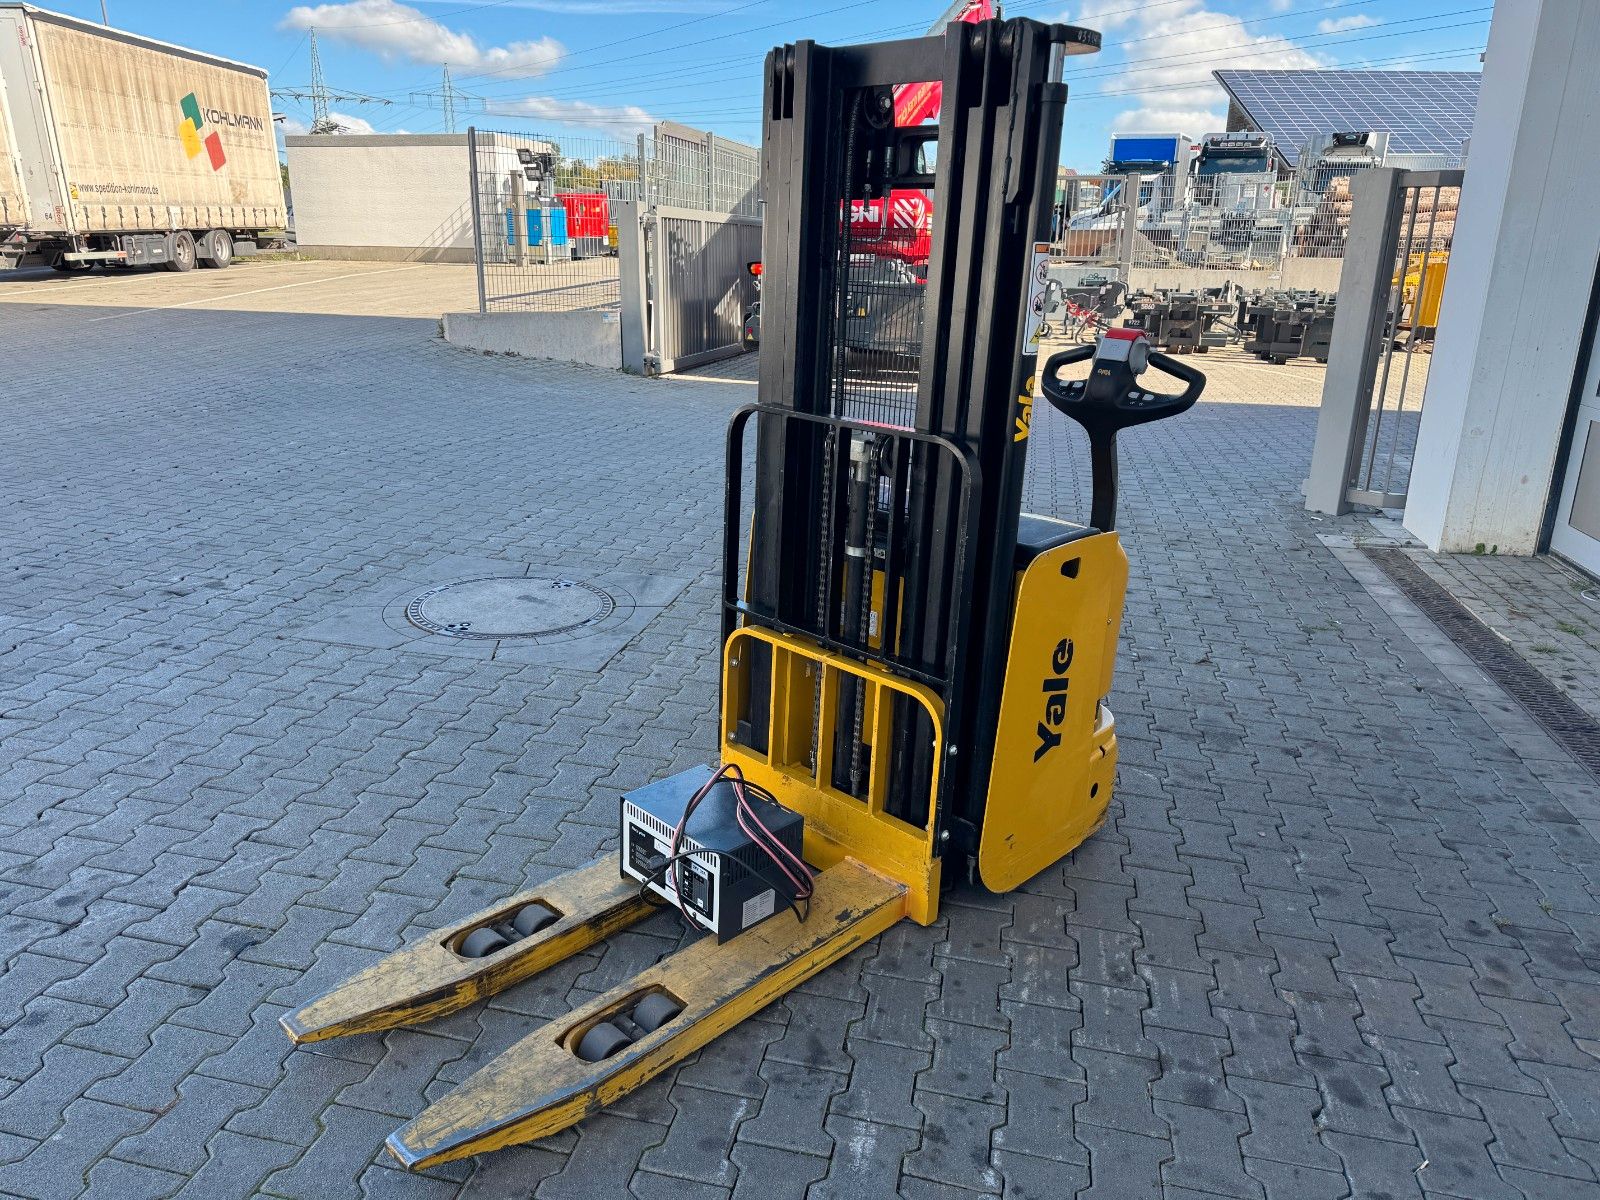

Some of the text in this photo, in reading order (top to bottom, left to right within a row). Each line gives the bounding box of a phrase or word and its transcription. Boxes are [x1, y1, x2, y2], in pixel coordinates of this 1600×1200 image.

[202, 107, 264, 131] KOHLMANN
[840, 205, 879, 223] GNI
[1033, 637, 1074, 763] Yale
